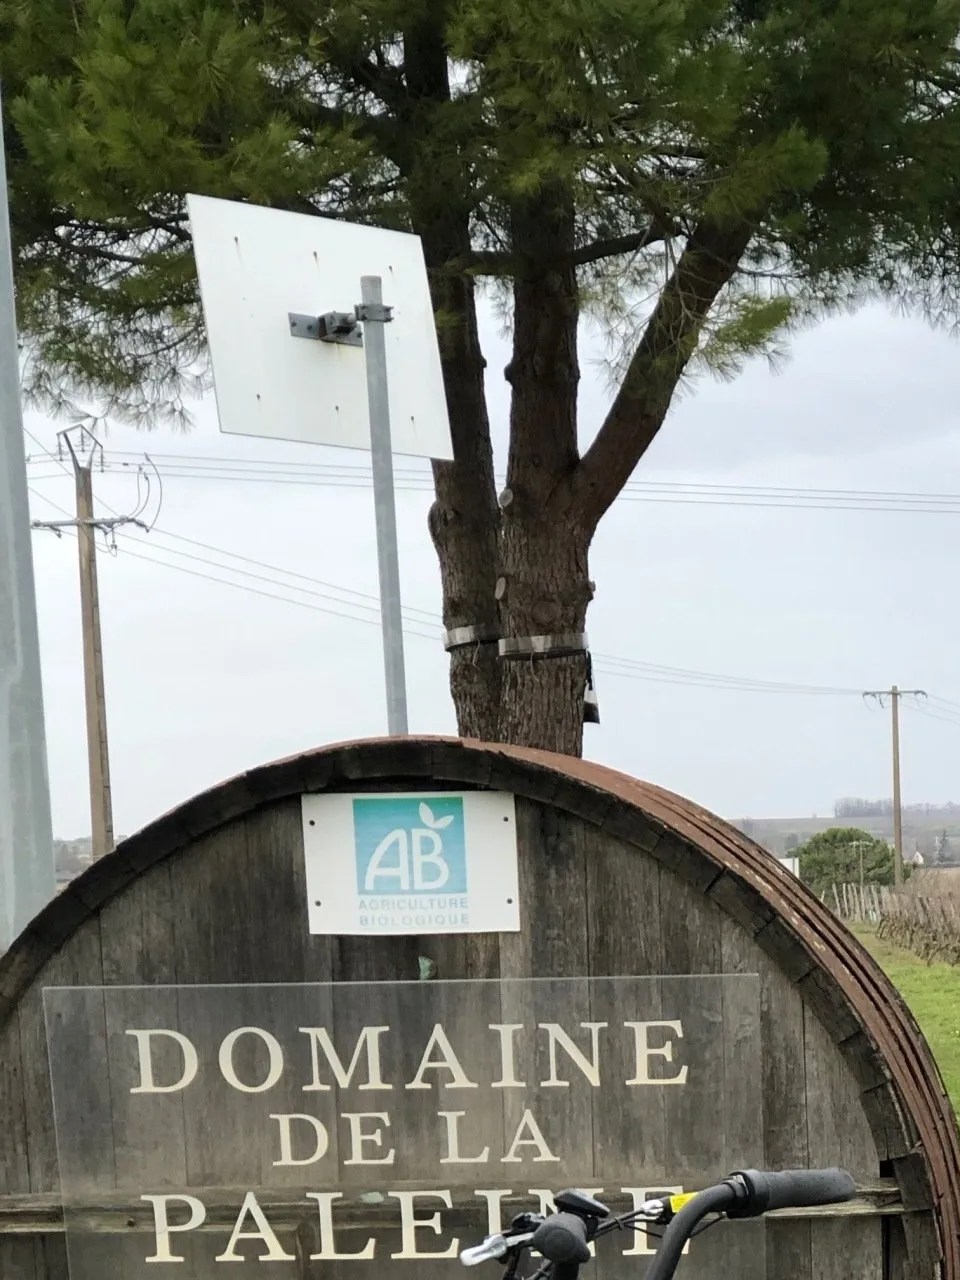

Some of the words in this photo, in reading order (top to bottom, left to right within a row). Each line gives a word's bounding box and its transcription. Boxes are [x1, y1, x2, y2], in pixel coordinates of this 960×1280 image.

[364, 827, 449, 891] AB
[358, 897, 470, 911] AGRICULTURE
[359, 913, 470, 927] BIOLOGIQUE
[125, 1019, 690, 1094] DOMAINE
[269, 1111, 395, 1167] DE
[438, 1108, 560, 1164] LA
